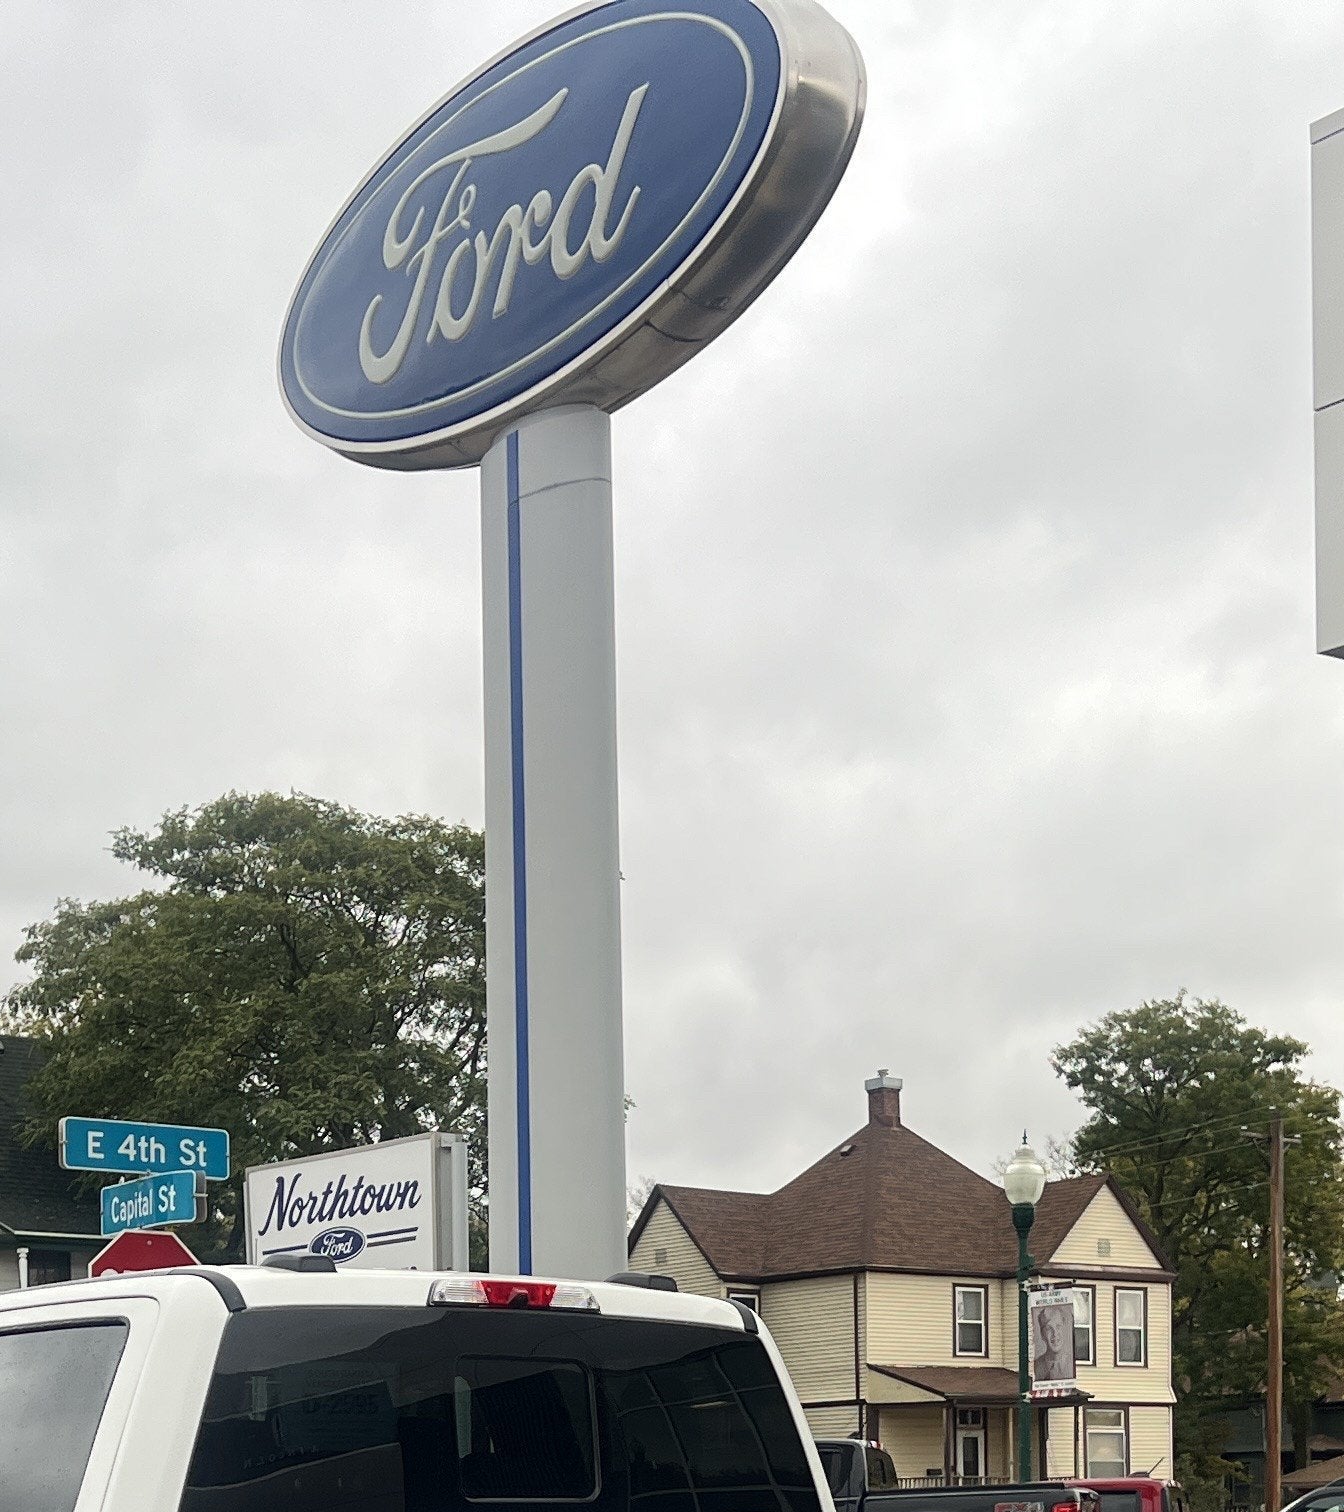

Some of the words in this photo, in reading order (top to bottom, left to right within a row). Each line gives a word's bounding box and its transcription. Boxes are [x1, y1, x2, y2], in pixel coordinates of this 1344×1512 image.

[359, 82, 650, 384] Ford
[87, 1130, 104, 1160] E
[117, 1134, 166, 1165] 4th
[179, 1139, 207, 1167] St
[110, 1188, 153, 1224] Capital
[157, 1185, 176, 1213] St
[258, 1173, 422, 1236] Northtown
[321, 1231, 354, 1258] Ford
